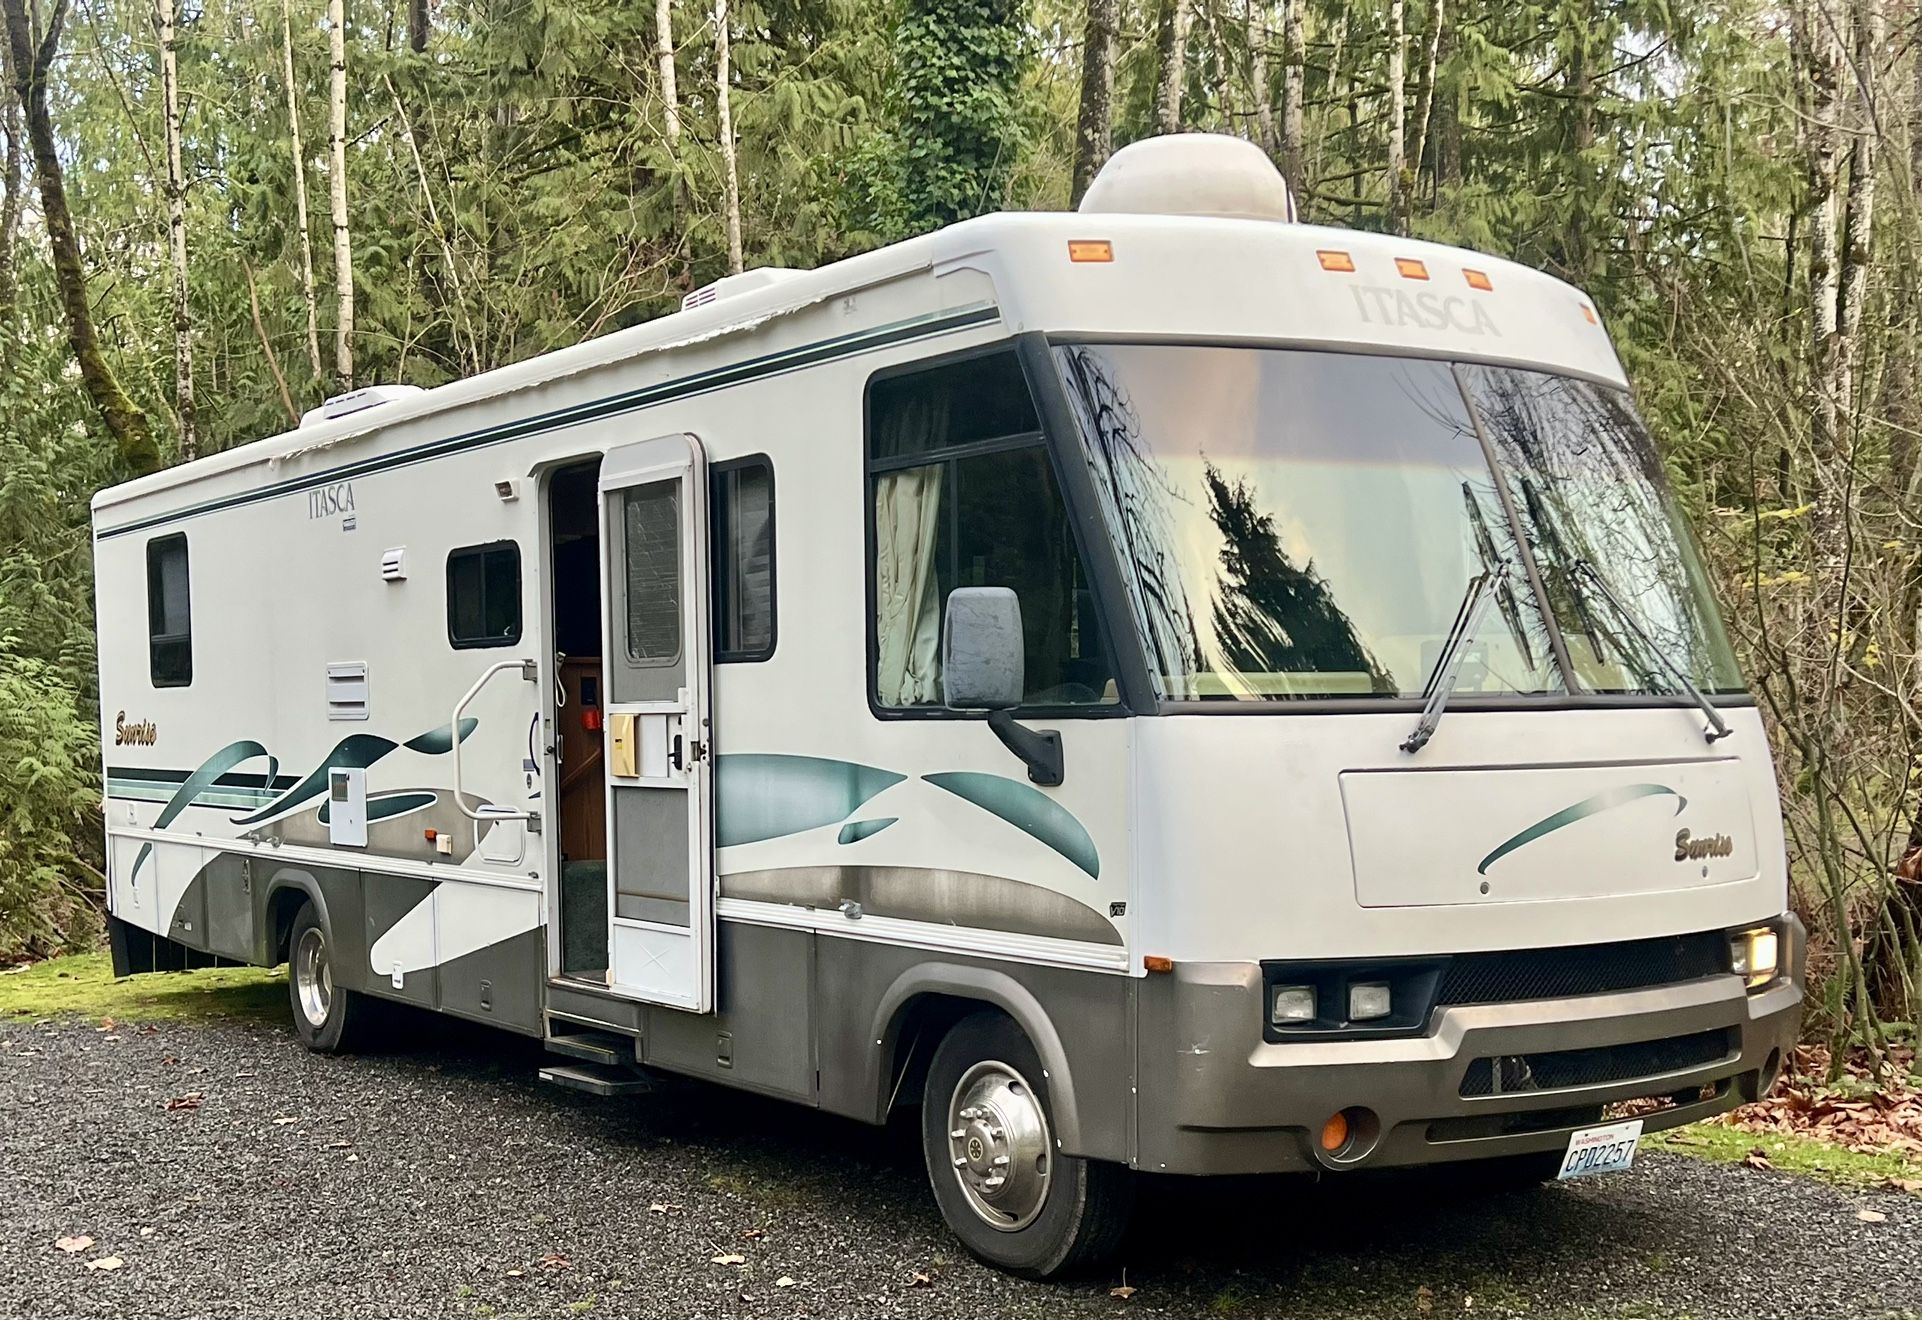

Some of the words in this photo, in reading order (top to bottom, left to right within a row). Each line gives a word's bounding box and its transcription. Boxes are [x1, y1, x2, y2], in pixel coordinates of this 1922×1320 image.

[1349, 284, 1502, 337] ITASCA
[308, 481, 355, 519] ITASCA
[115, 710, 157, 746] Sunrise
[1565, 1139, 1636, 1172] CPD2257
